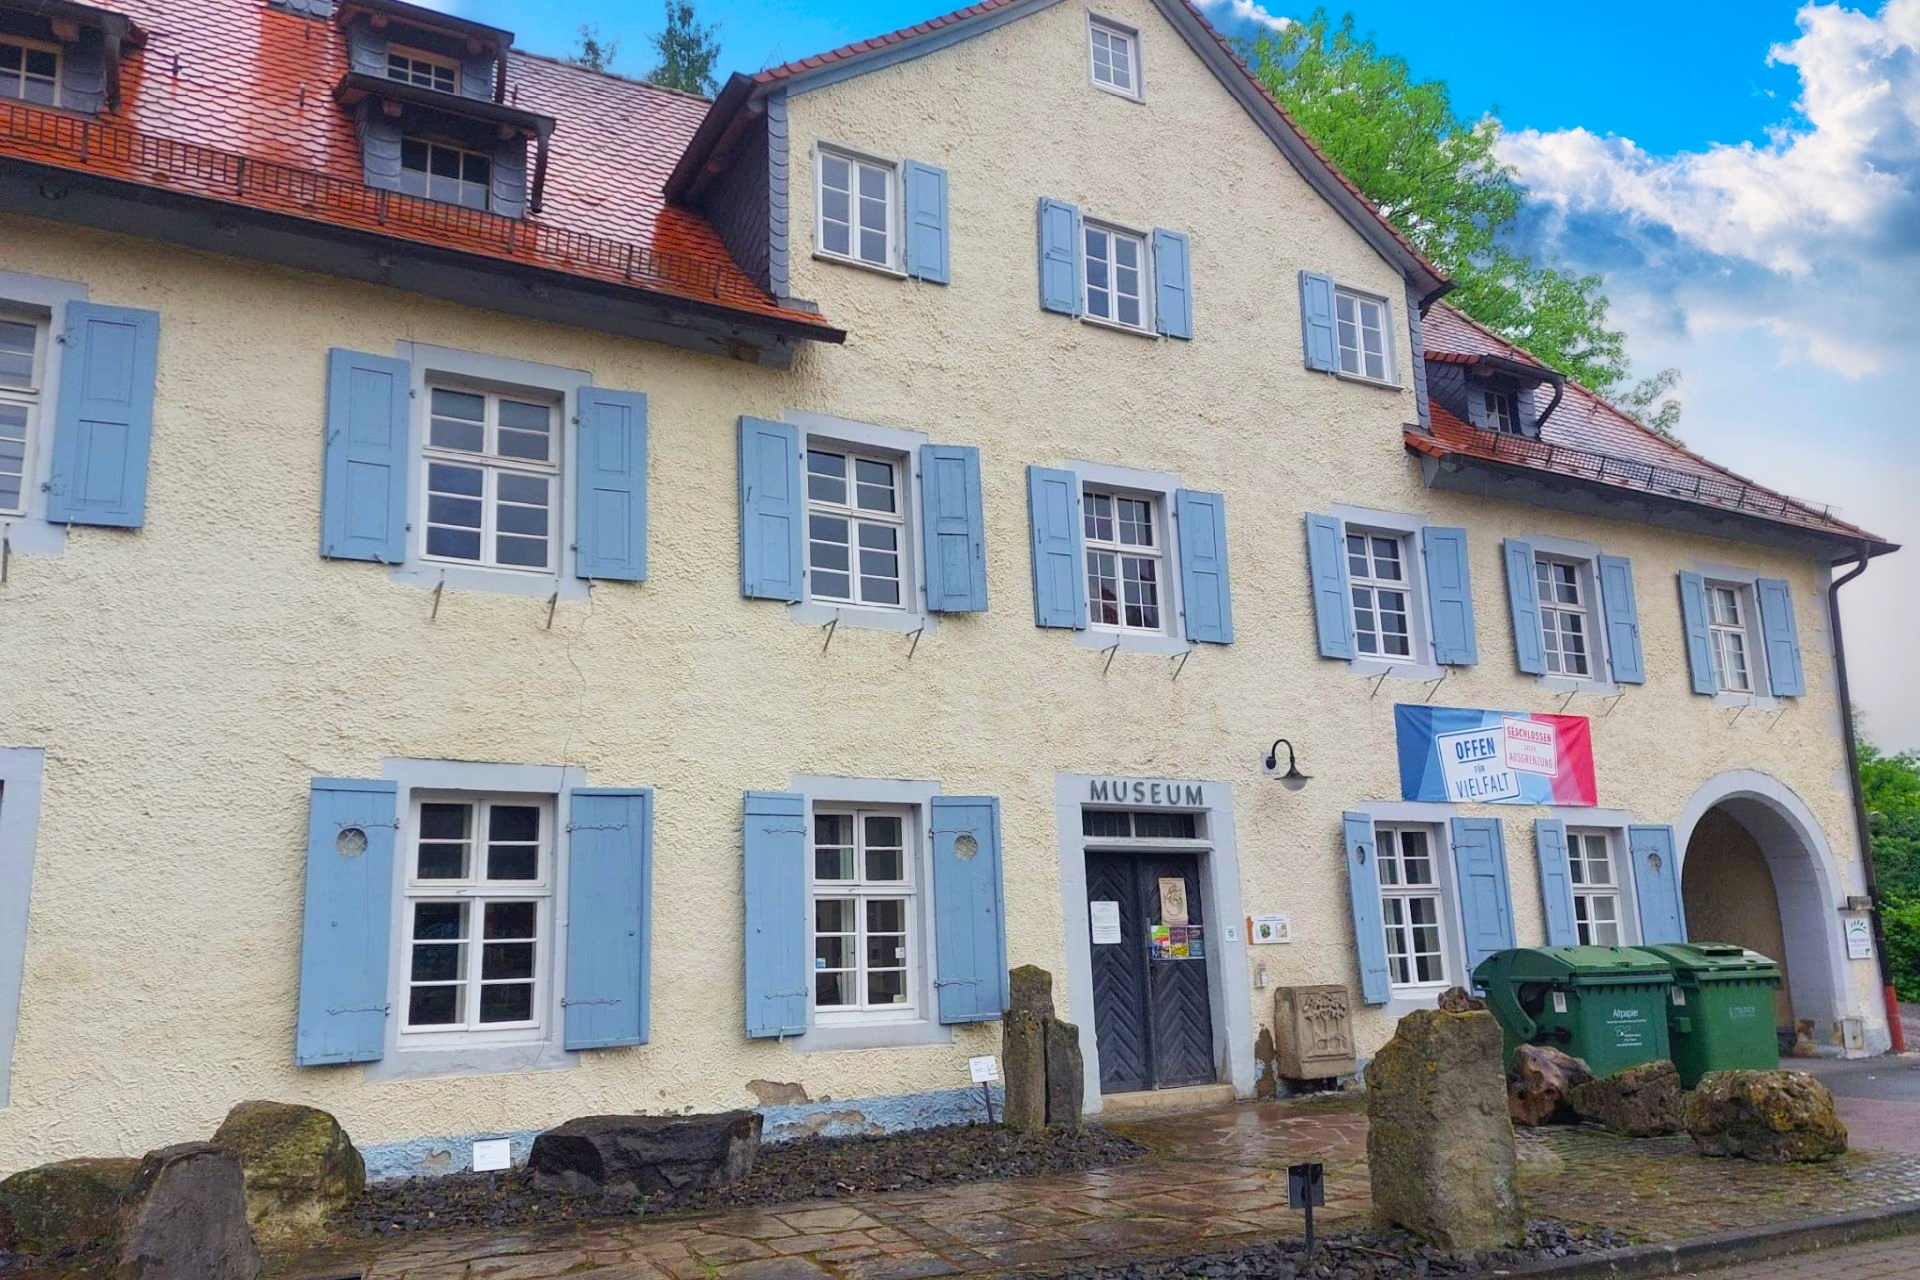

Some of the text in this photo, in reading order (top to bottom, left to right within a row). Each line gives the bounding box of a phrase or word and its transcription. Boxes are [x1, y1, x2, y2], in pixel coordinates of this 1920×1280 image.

[1507, 726, 1552, 742] GESCHLOSSEN
[1455, 737, 1496, 760] OFFEN
[1474, 763, 1486, 774] FÜR
[1509, 752, 1553, 768] AUSGRENZUNG
[1090, 780, 1203, 805] MUSEUM
[1455, 772, 1510, 798] VIELFALT
